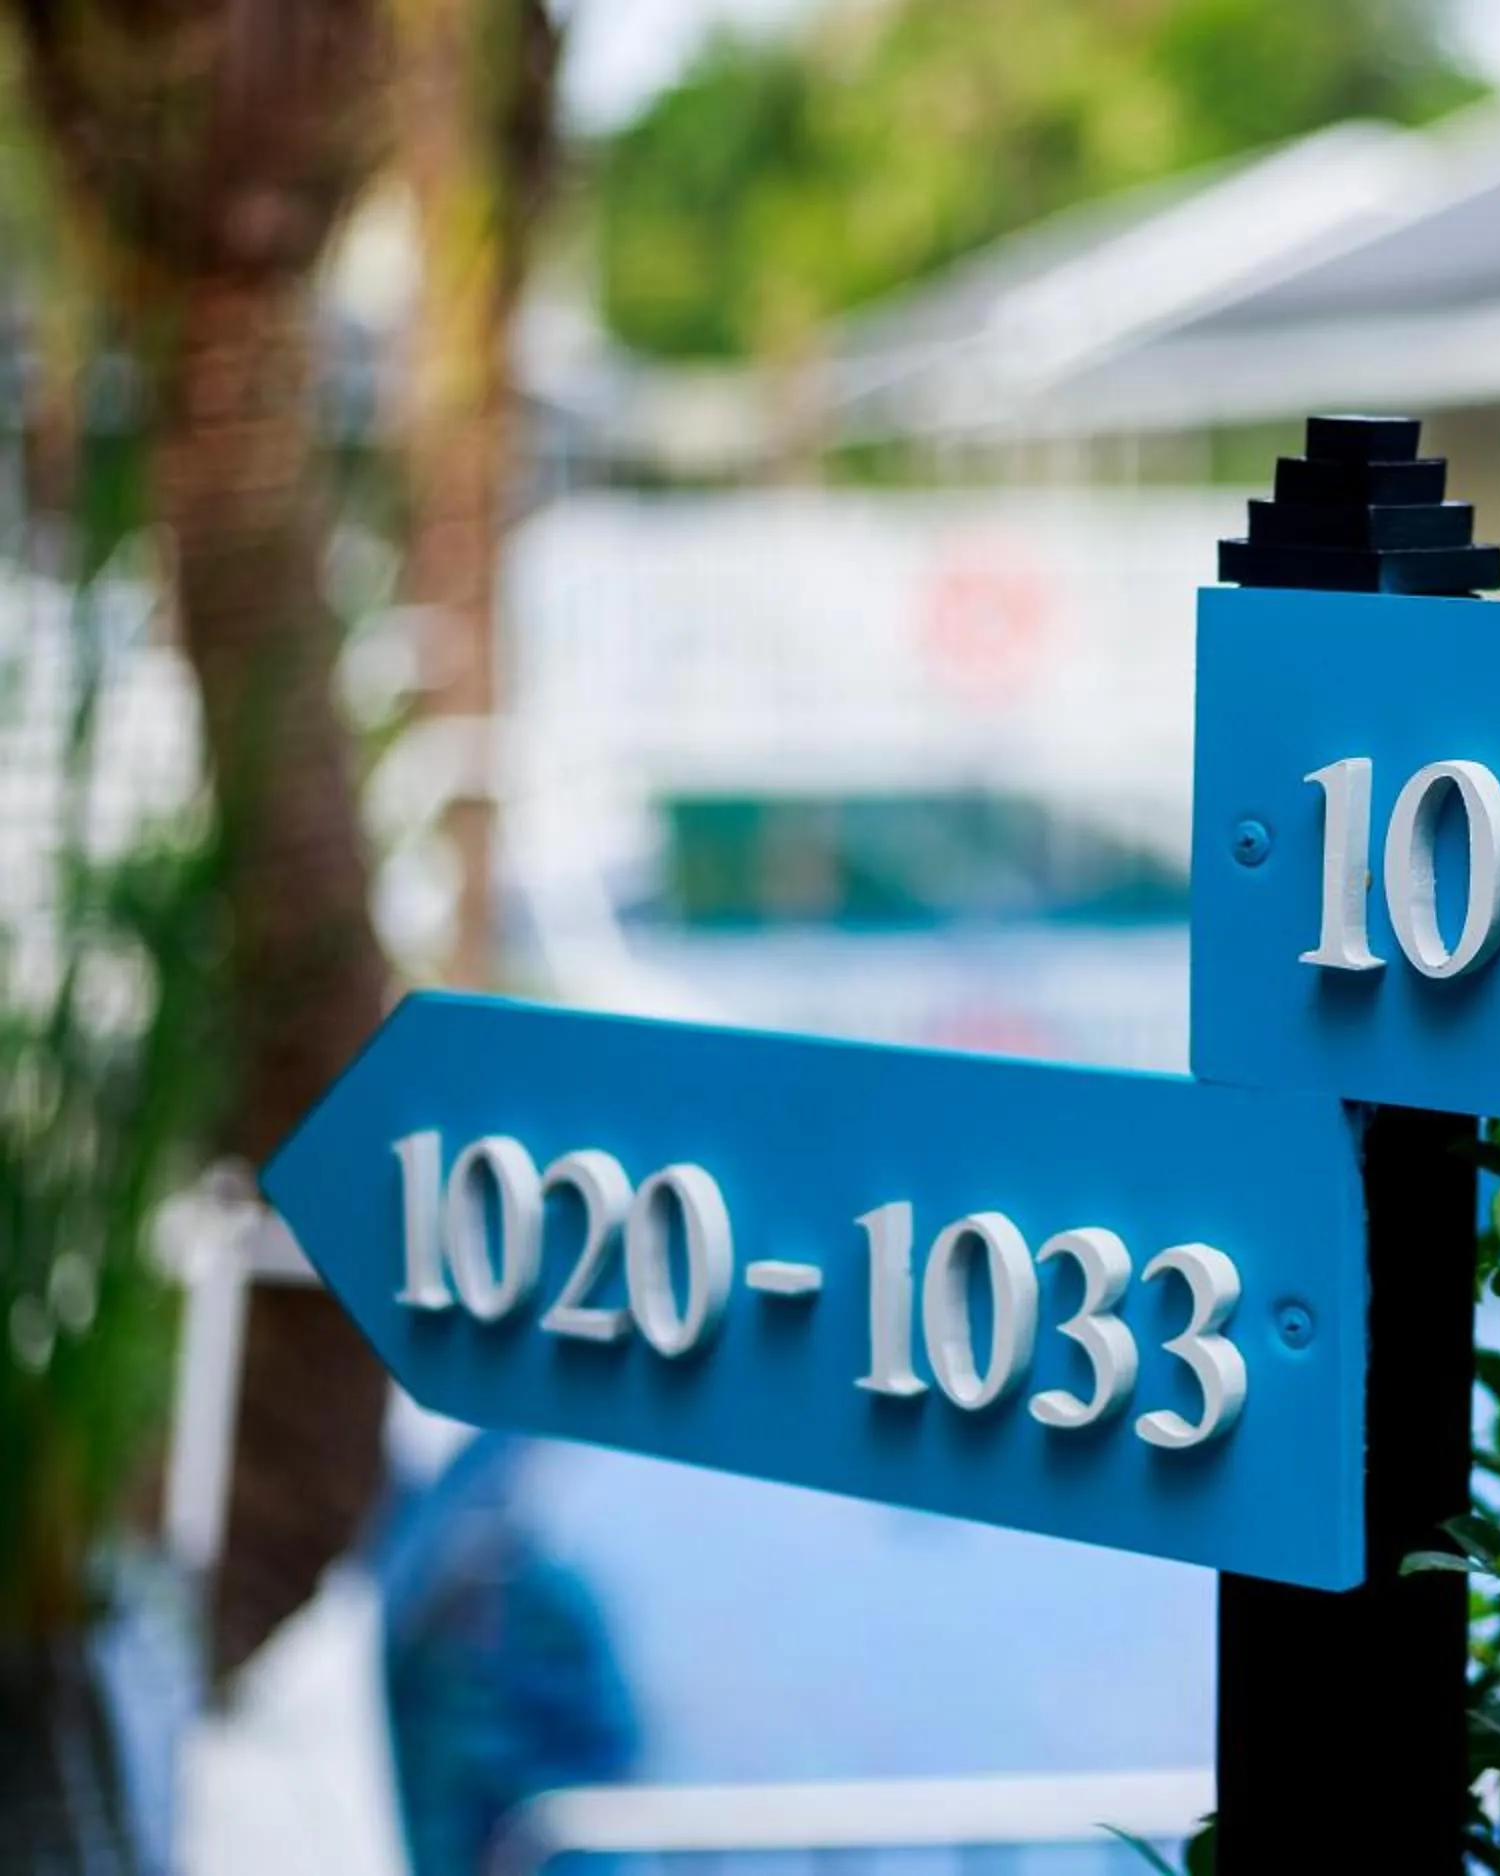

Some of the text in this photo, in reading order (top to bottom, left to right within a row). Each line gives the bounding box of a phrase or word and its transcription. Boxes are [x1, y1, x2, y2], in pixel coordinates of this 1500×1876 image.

[392, 1130, 1248, 1450] 1020 - 1033
